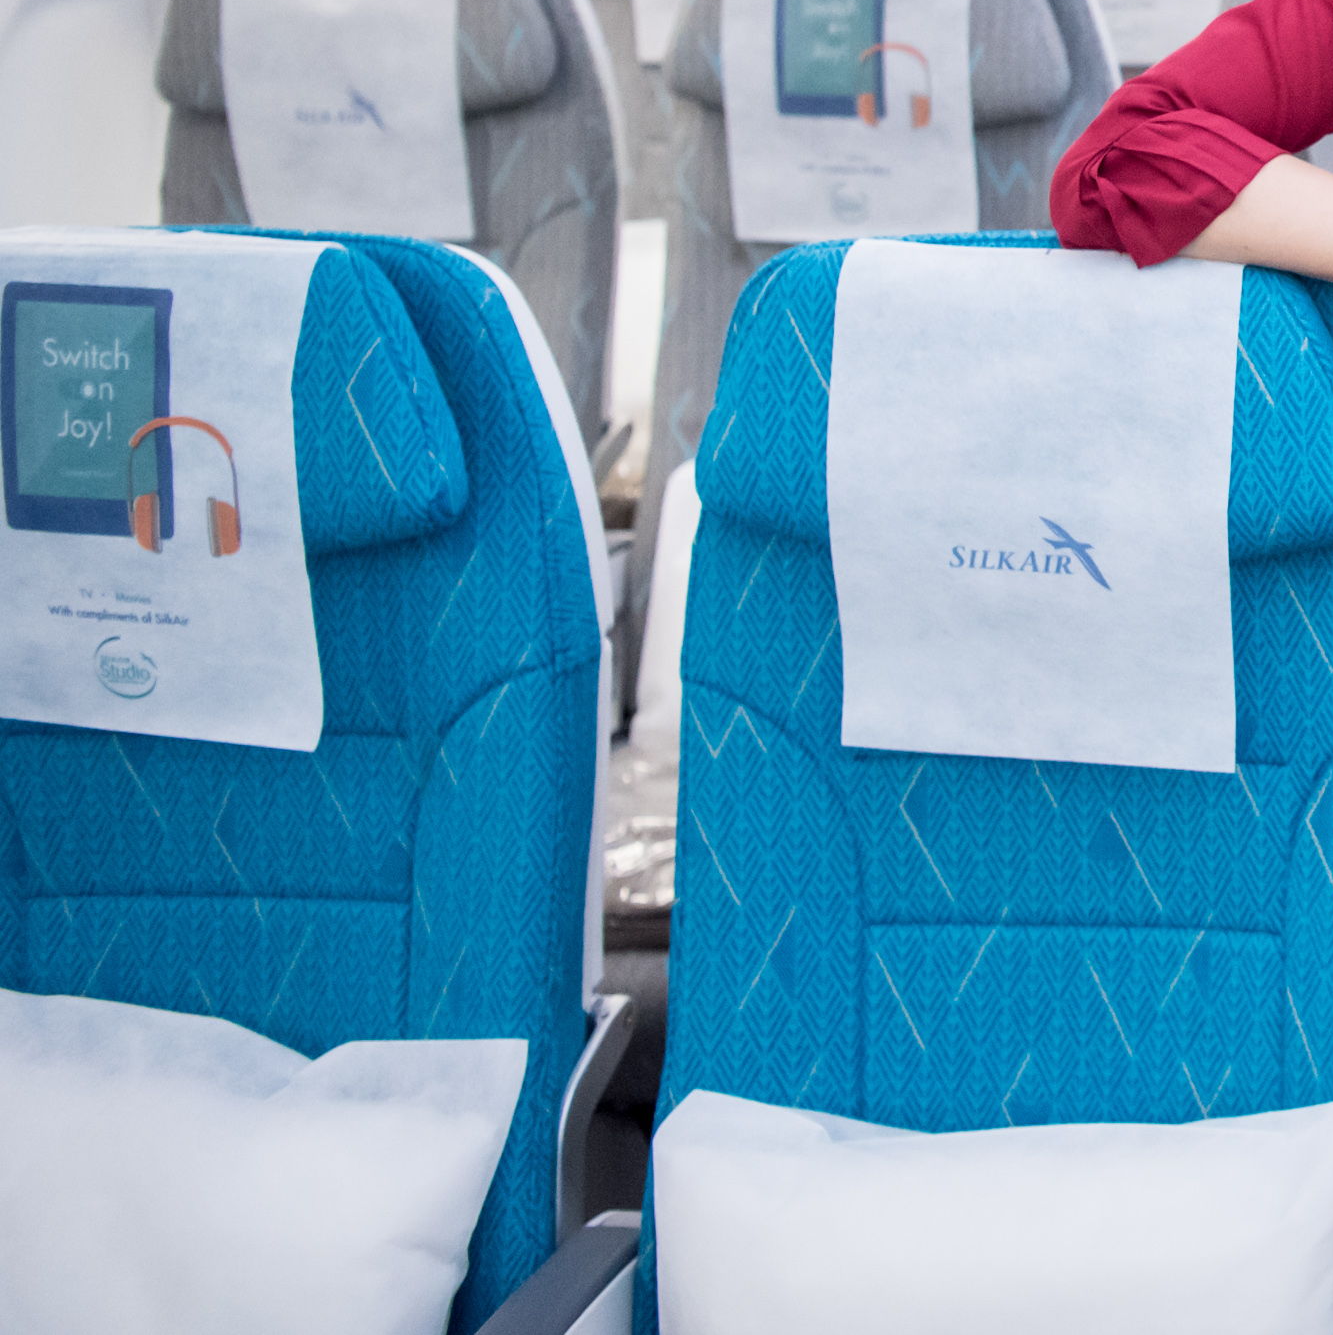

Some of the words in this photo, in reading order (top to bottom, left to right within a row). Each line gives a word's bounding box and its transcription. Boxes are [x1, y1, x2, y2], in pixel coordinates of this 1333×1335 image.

[43, 338, 130, 370] Switch
[57, 409, 112, 448] Joy!
[79, 588, 92, 599] TV
[48, 605, 73, 616] With
[76, 609, 139, 622] compliments
[141, 611, 152, 624] of
[154, 612, 189, 625] SilkAir
[100, 664, 151, 681] Studio
